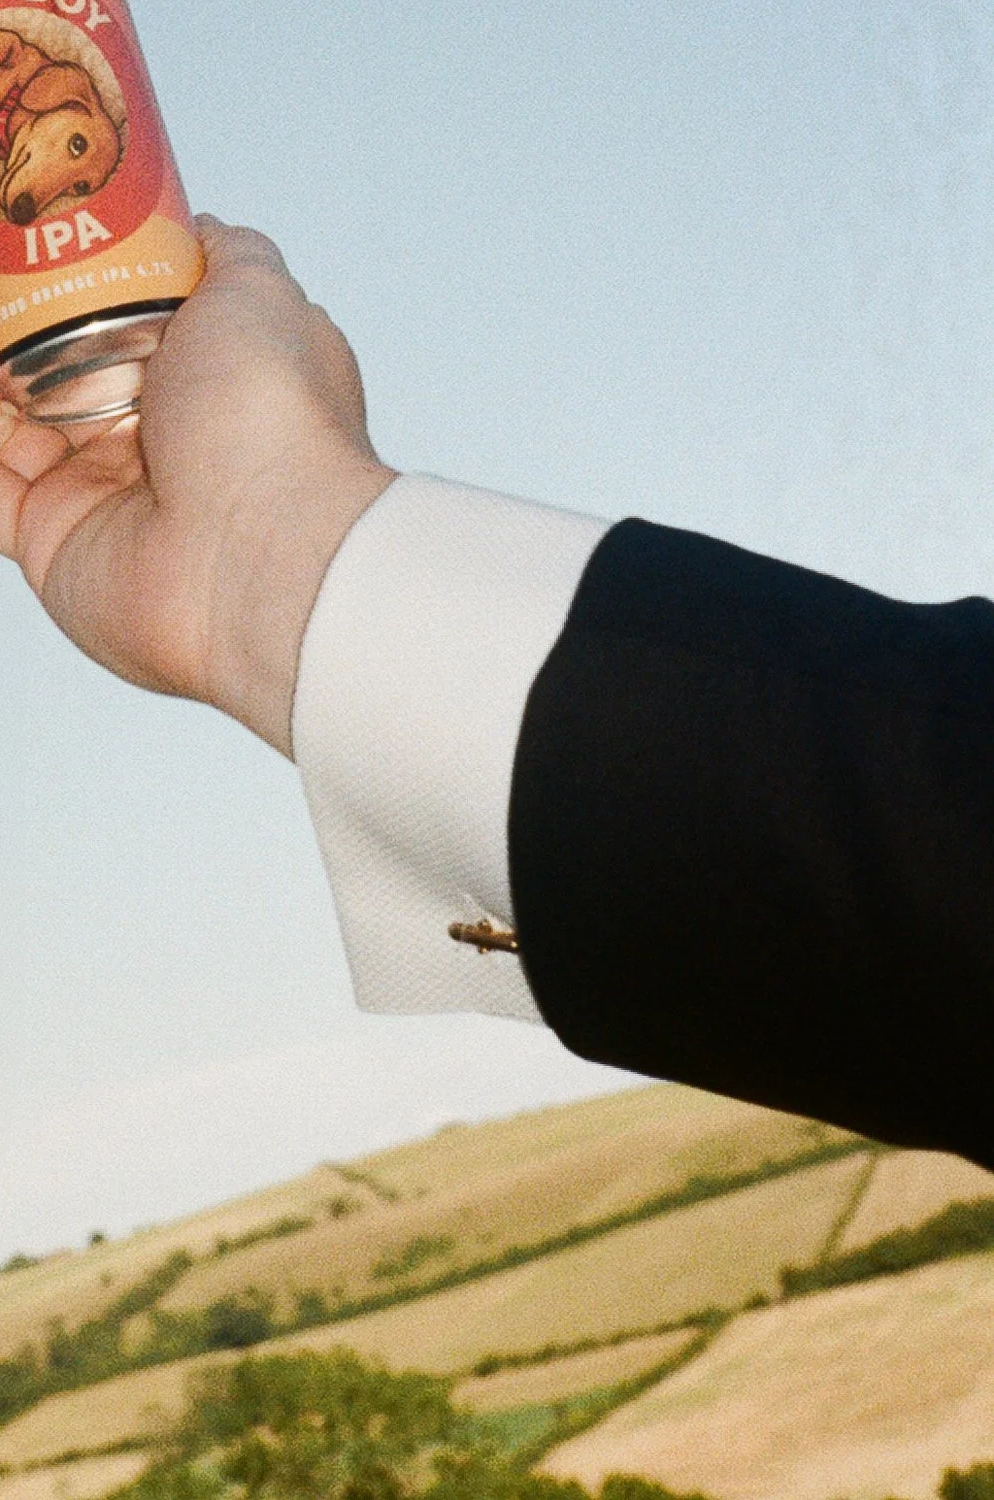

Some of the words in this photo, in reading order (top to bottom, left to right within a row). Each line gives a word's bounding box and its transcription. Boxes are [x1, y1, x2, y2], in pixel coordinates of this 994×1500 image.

[24, 209, 114, 265] IPA
[31, 274, 96, 306] ORANGE
[102, 266, 131, 284] IPA
